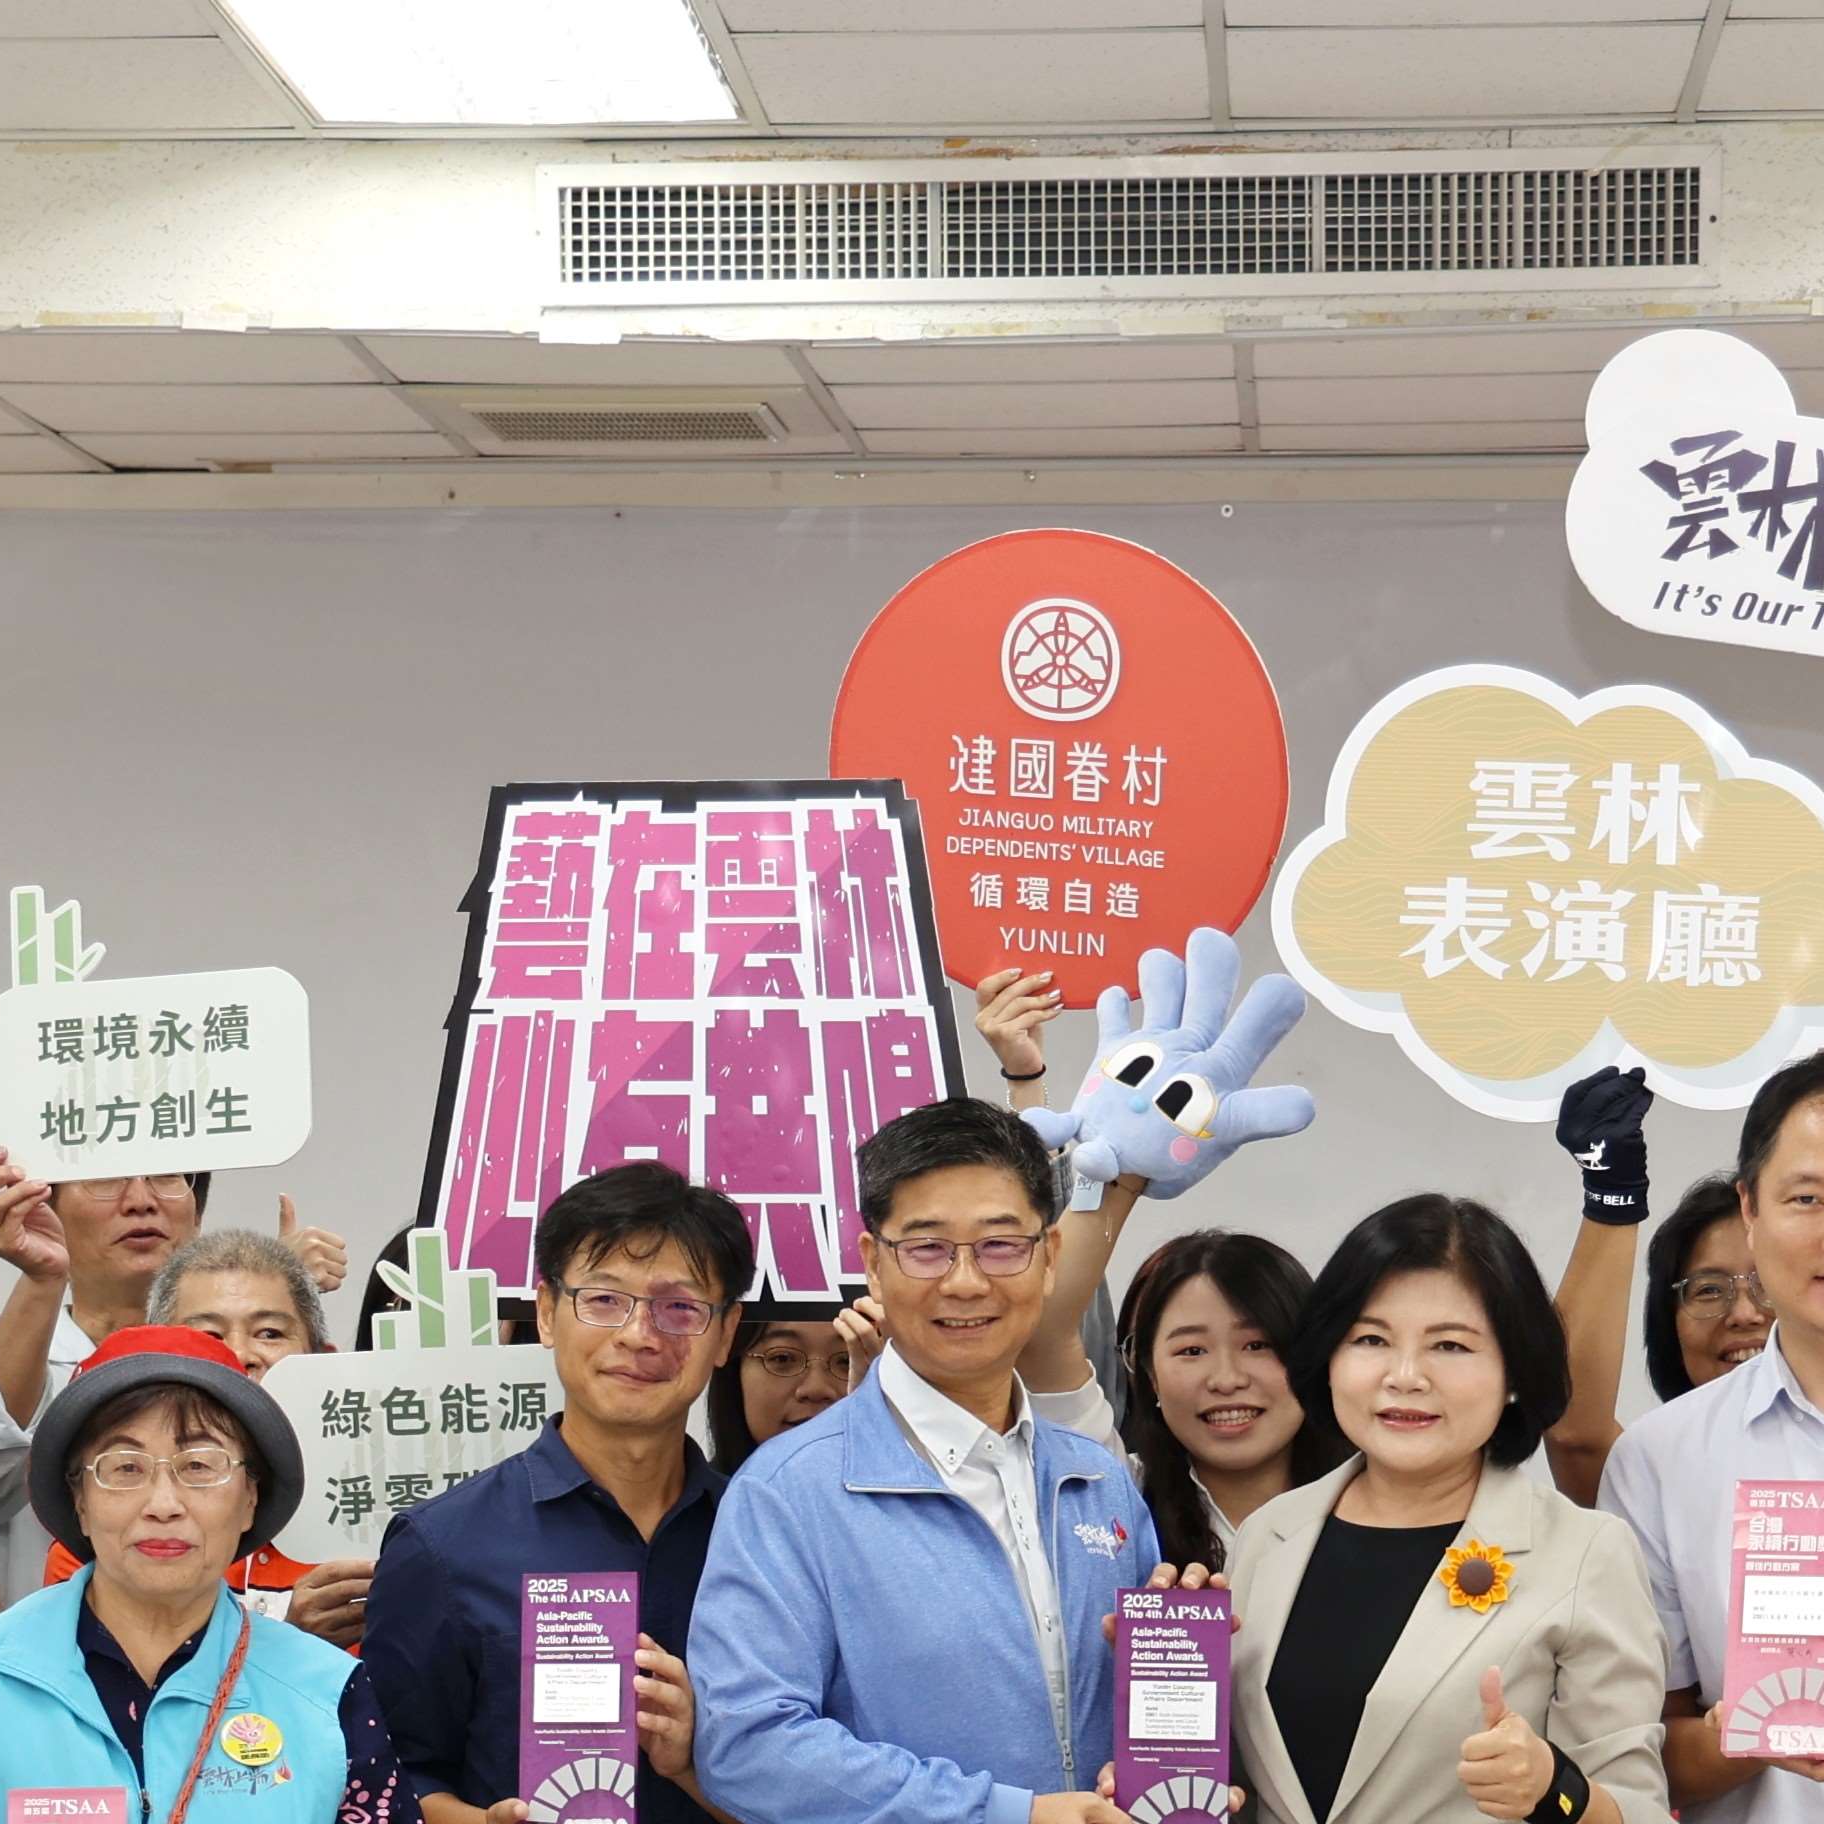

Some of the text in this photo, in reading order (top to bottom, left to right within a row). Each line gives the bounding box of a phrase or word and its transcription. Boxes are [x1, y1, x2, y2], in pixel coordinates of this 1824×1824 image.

[1652, 580, 1724, 617] It's
[1738, 591, 1806, 628] Our
[949, 735, 1167, 807] 建國眷村
[1466, 760, 1703, 865] 雲林
[959, 809, 1154, 839] JIANGUO MILITARY
[946, 837, 1165, 868] DEPENDENTS' VILLAGE
[970, 872, 1140, 919] 循環自造
[1398, 876, 1763, 988] 表演廳
[1000, 926, 1105, 957] YUNLIN
[37, 1004, 250, 1065] 環境永續
[39, 1087, 252, 1147] 地方創生
[1603, 1195, 1635, 1205] BELL
[320, 1382, 548, 1439] 綠色能源
[325, 1470, 480, 1526] 淨零
[1750, 1490, 1775, 1498] 2025
[528, 1579, 568, 1593] 2025
[528, 1589, 631, 1603] The 4th APSAA
[1123, 1594, 1163, 1608] 2025
[537, 1611, 593, 1622] Asia-Pacific
[1123, 1606, 1225, 1620] The 4th APSAA
[537, 1623, 603, 1634] Sustainability
[1131, 1627, 1188, 1638] Asia-Pacific
[537, 1635, 609, 1644] Action Awards
[1131, 1639, 1198, 1651] Sustainability
[1131, 1651, 1204, 1662] Action Awards
[51, 1799, 110, 1815] TSAA
